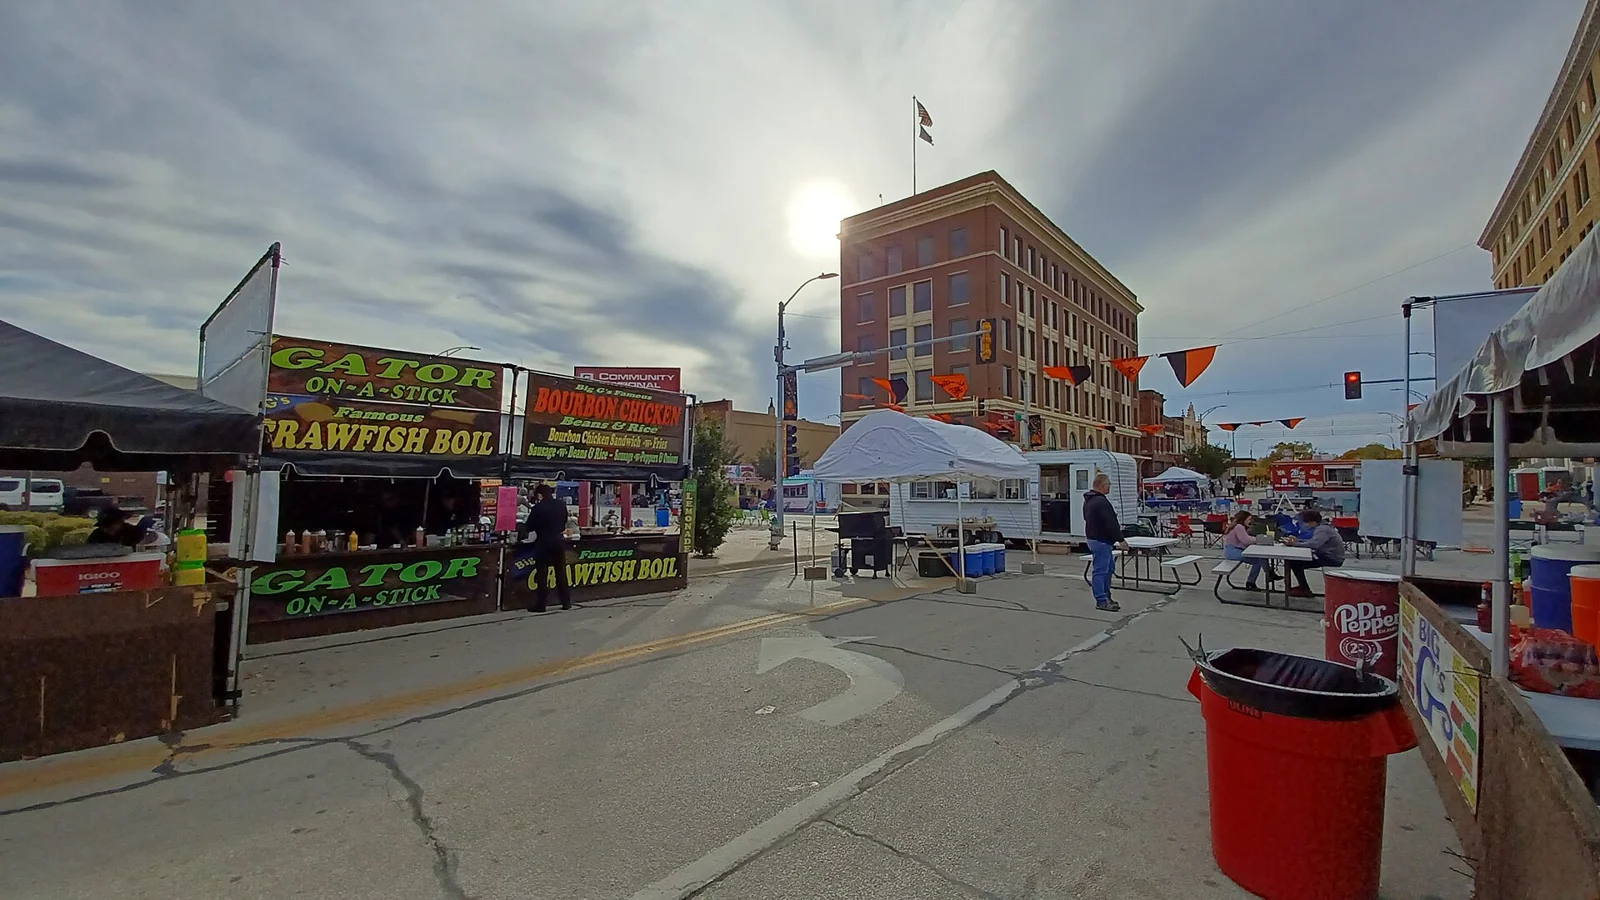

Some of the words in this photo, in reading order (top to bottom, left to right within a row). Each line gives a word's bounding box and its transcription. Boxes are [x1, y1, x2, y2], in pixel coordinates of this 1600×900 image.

[271, 347, 496, 388] GATOR
[599, 372, 675, 381] COMMUNITY
[575, 384, 594, 394] Big
[596, 386, 612, 395] G's
[614, 390, 653, 401] Famous
[333, 406, 425, 423] Famous
[534, 387, 619, 419] BOURBON
[620, 399, 682, 426] CHICKEN
[560, 416, 609, 429] Beans
[611, 421, 627, 431] &
[627, 423, 659, 434] Rice
[430, 429, 493, 456] BOIL
[548, 427, 581, 444] Bourbon
[582, 430, 610, 446] Chicken
[610, 433, 642, 448] Sandwich
[652, 437, 668, 449] Fries
[527, 443, 557, 460] Sausage
[567, 445, 588, 459] Beans
[593, 447, 609, 460] Rice
[684, 492, 693, 553] LEMONADE
[514, 556, 536, 570] Big
[578, 549, 633, 560] Famous
[250, 557, 481, 595] GATOR
[636, 557, 678, 580] BOIL
[1357, 602, 1387, 620] Dr
[1419, 617, 1440, 661] BIG
